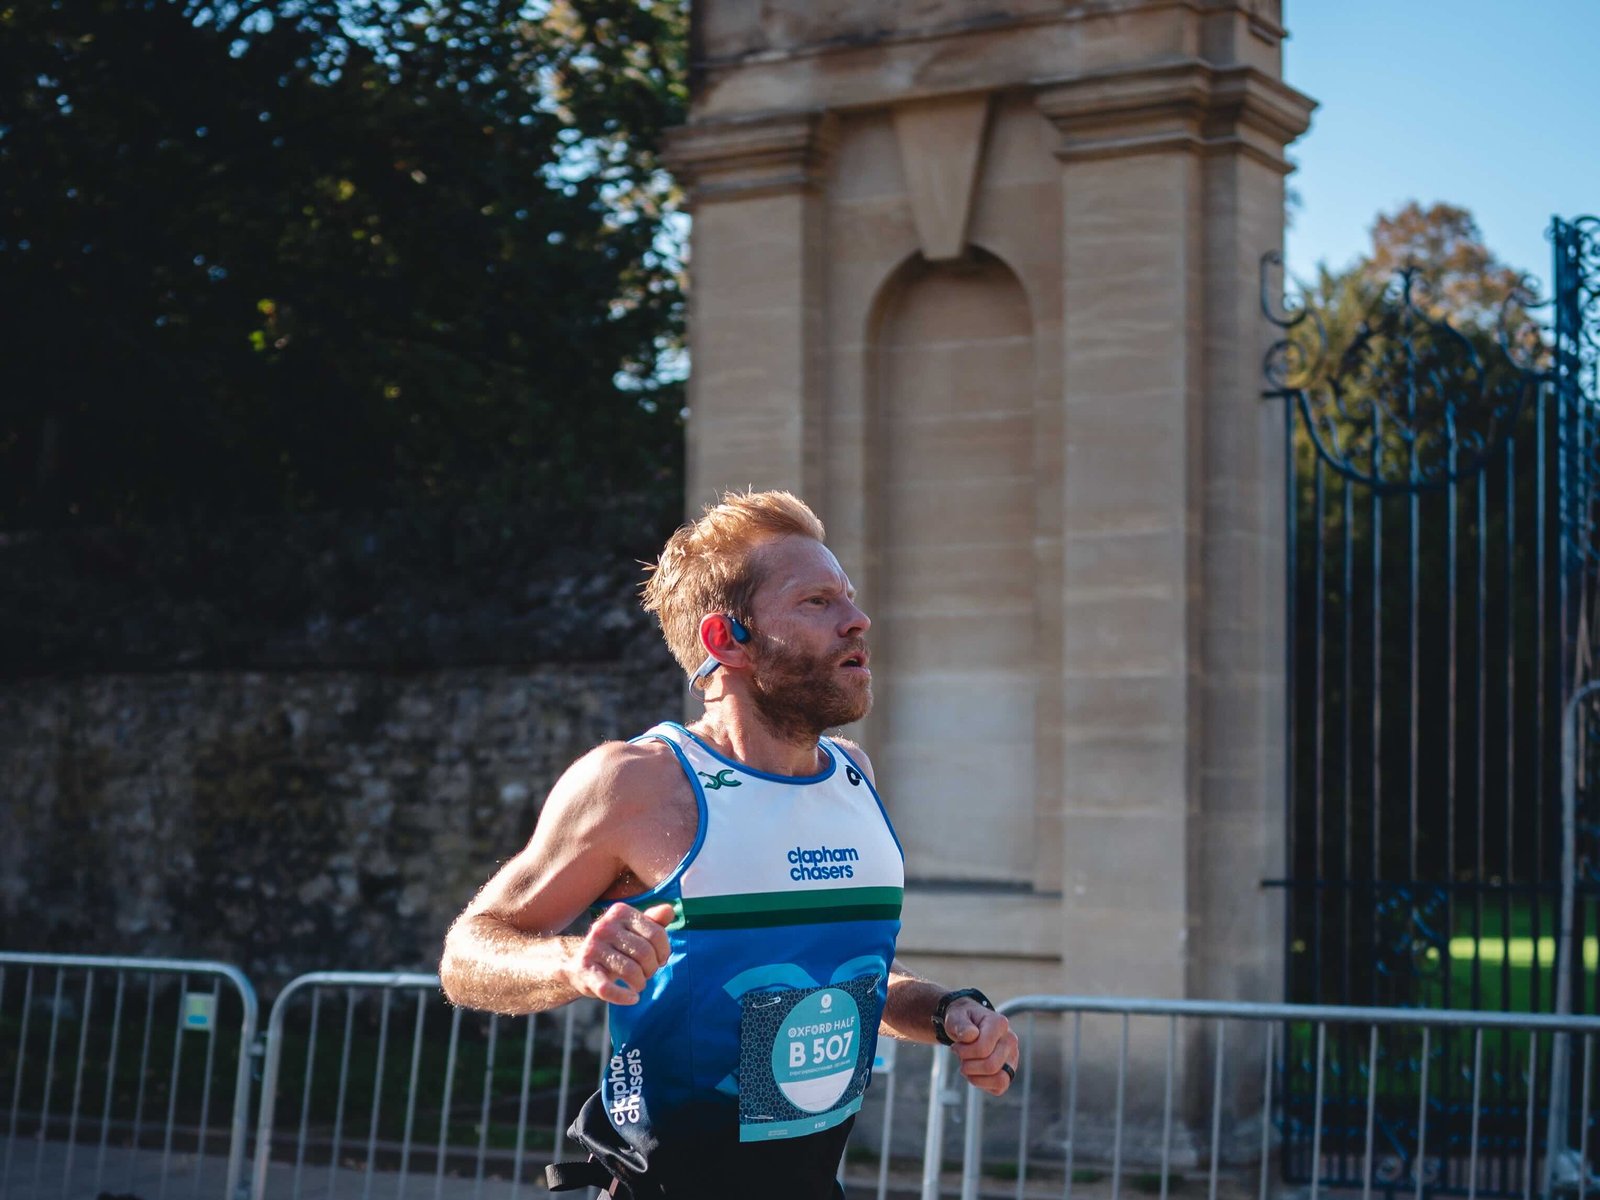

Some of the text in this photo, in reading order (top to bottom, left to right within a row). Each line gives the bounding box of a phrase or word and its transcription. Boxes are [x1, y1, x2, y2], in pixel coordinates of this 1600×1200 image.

[787, 846, 859, 867] clapham
[790, 863, 854, 881] chasers
[788, 1016, 855, 1038] OXFORD HALF
[789, 1041, 806, 1068] B
[812, 1030, 854, 1064] 507
[626, 1048, 644, 1124] chasers
